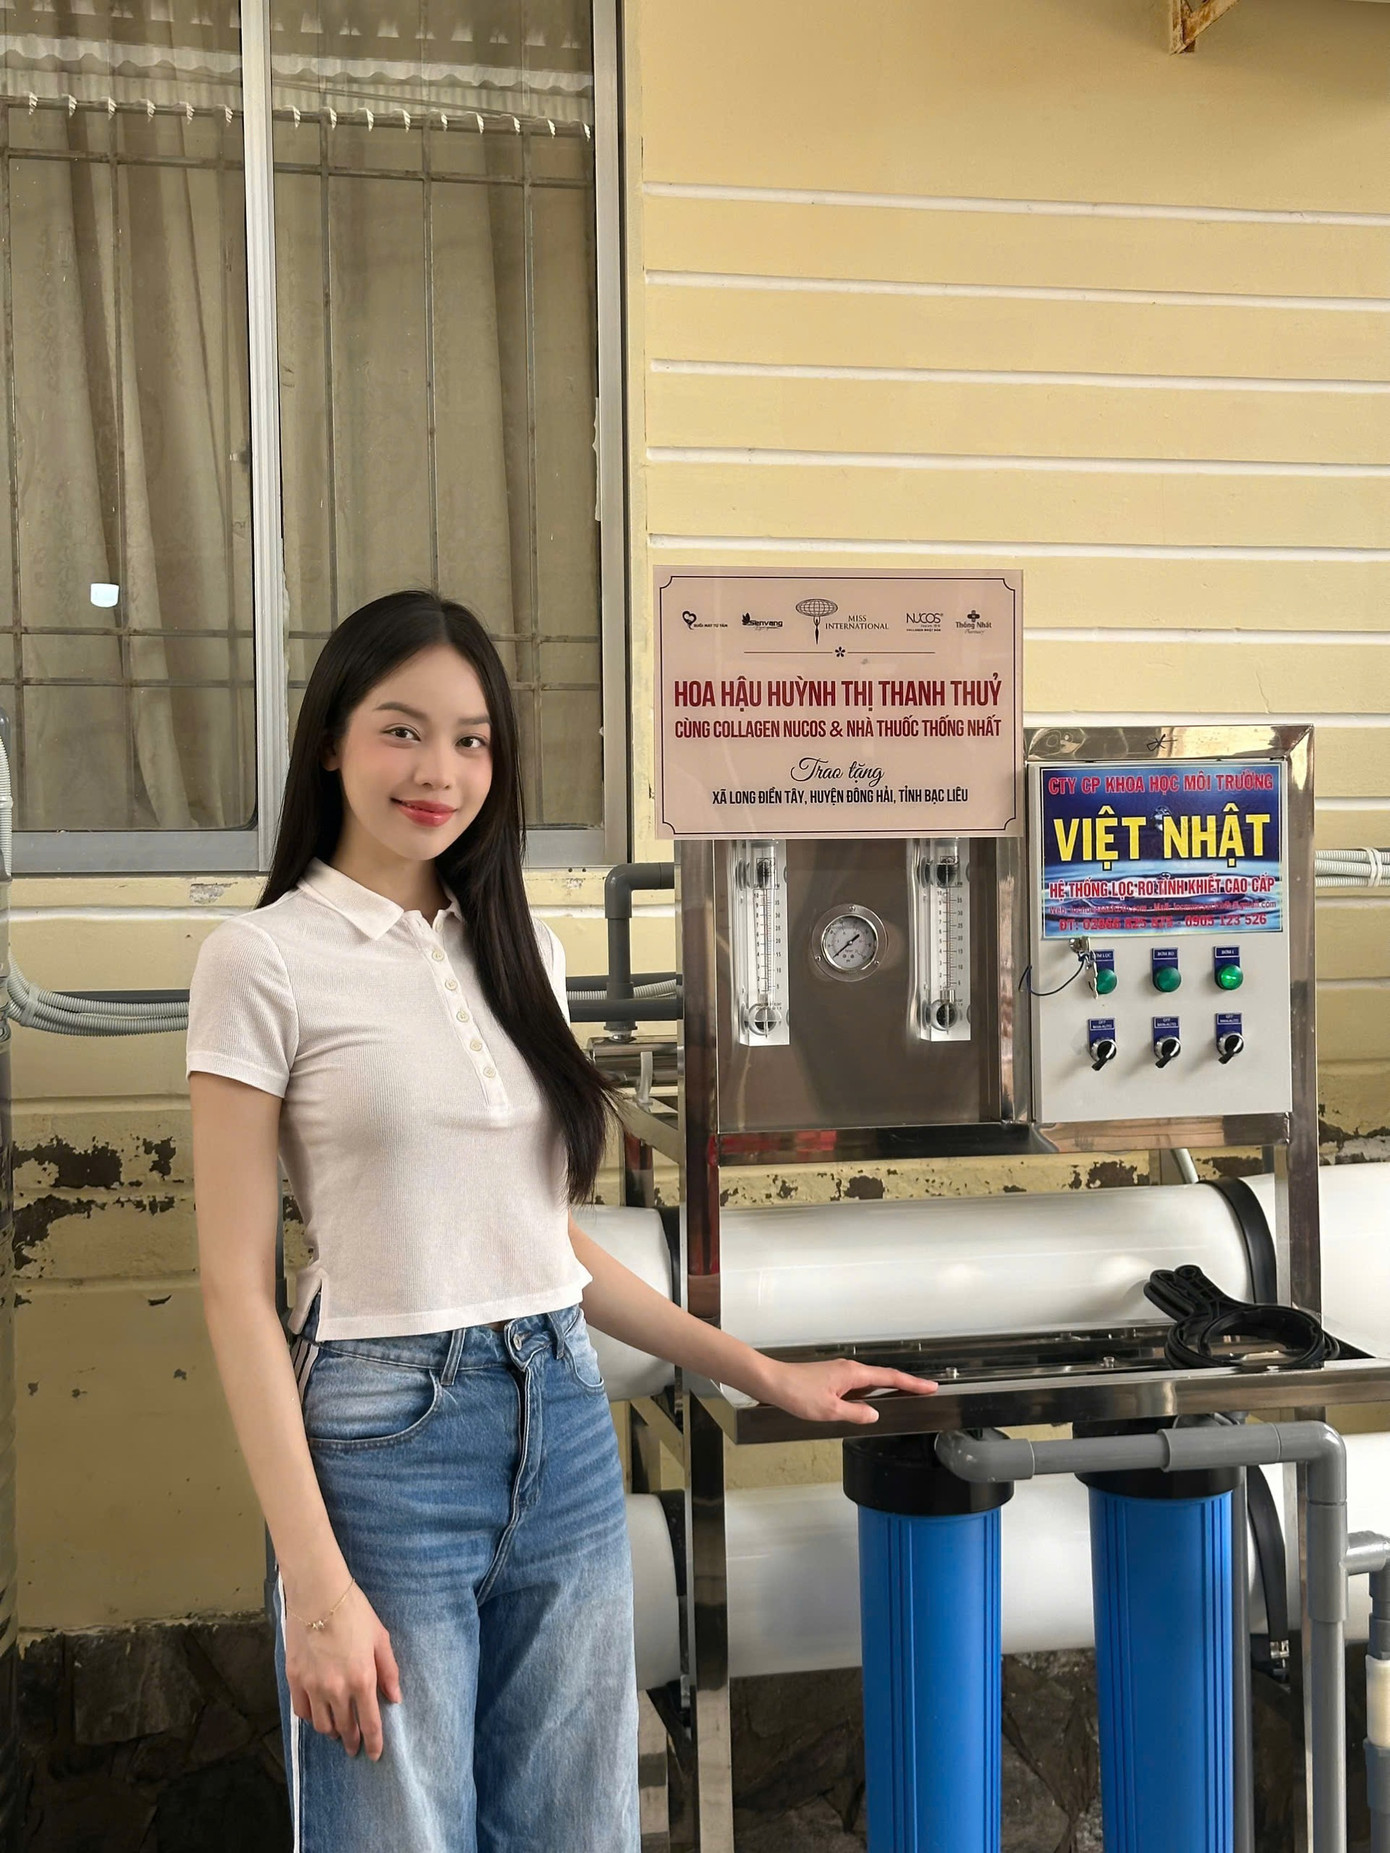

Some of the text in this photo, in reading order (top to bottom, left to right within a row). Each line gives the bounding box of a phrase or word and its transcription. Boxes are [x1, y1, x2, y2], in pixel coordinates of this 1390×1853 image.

[675, 672, 1002, 712] HOA HẬU HUỲNH THỊ THANH THUỶ
[675, 714, 1001, 738] CÙNG COLLAGEN NUCOS & NHÀ THUỐC THỐNG NHẤT
[790, 757, 885, 787] Trao tặng
[1048, 768, 1274, 795] CTY CP KHOA HỌC MÔI TRƯỜNG
[712, 785, 968, 806] XÃ LONG ĐIỀN TÂY, HUYỆN ĐÔNG HẢI, TỈNH BẠC LIÊU
[1053, 802, 1270, 870] VIỆT NHẬT
[1049, 878, 1065, 902] HỆ
[1067, 876, 1108, 897] THỐNG
[1111, 881, 1134, 901] LỌC
[1138, 881, 1153, 896] RO
[1188, 873, 1221, 894] KHIẾT
[1225, 878, 1247, 893] CAO
[1251, 872, 1275, 892] CẤP
[1220, 914, 1241, 926] 123
[1245, 913, 1266, 925] 526
